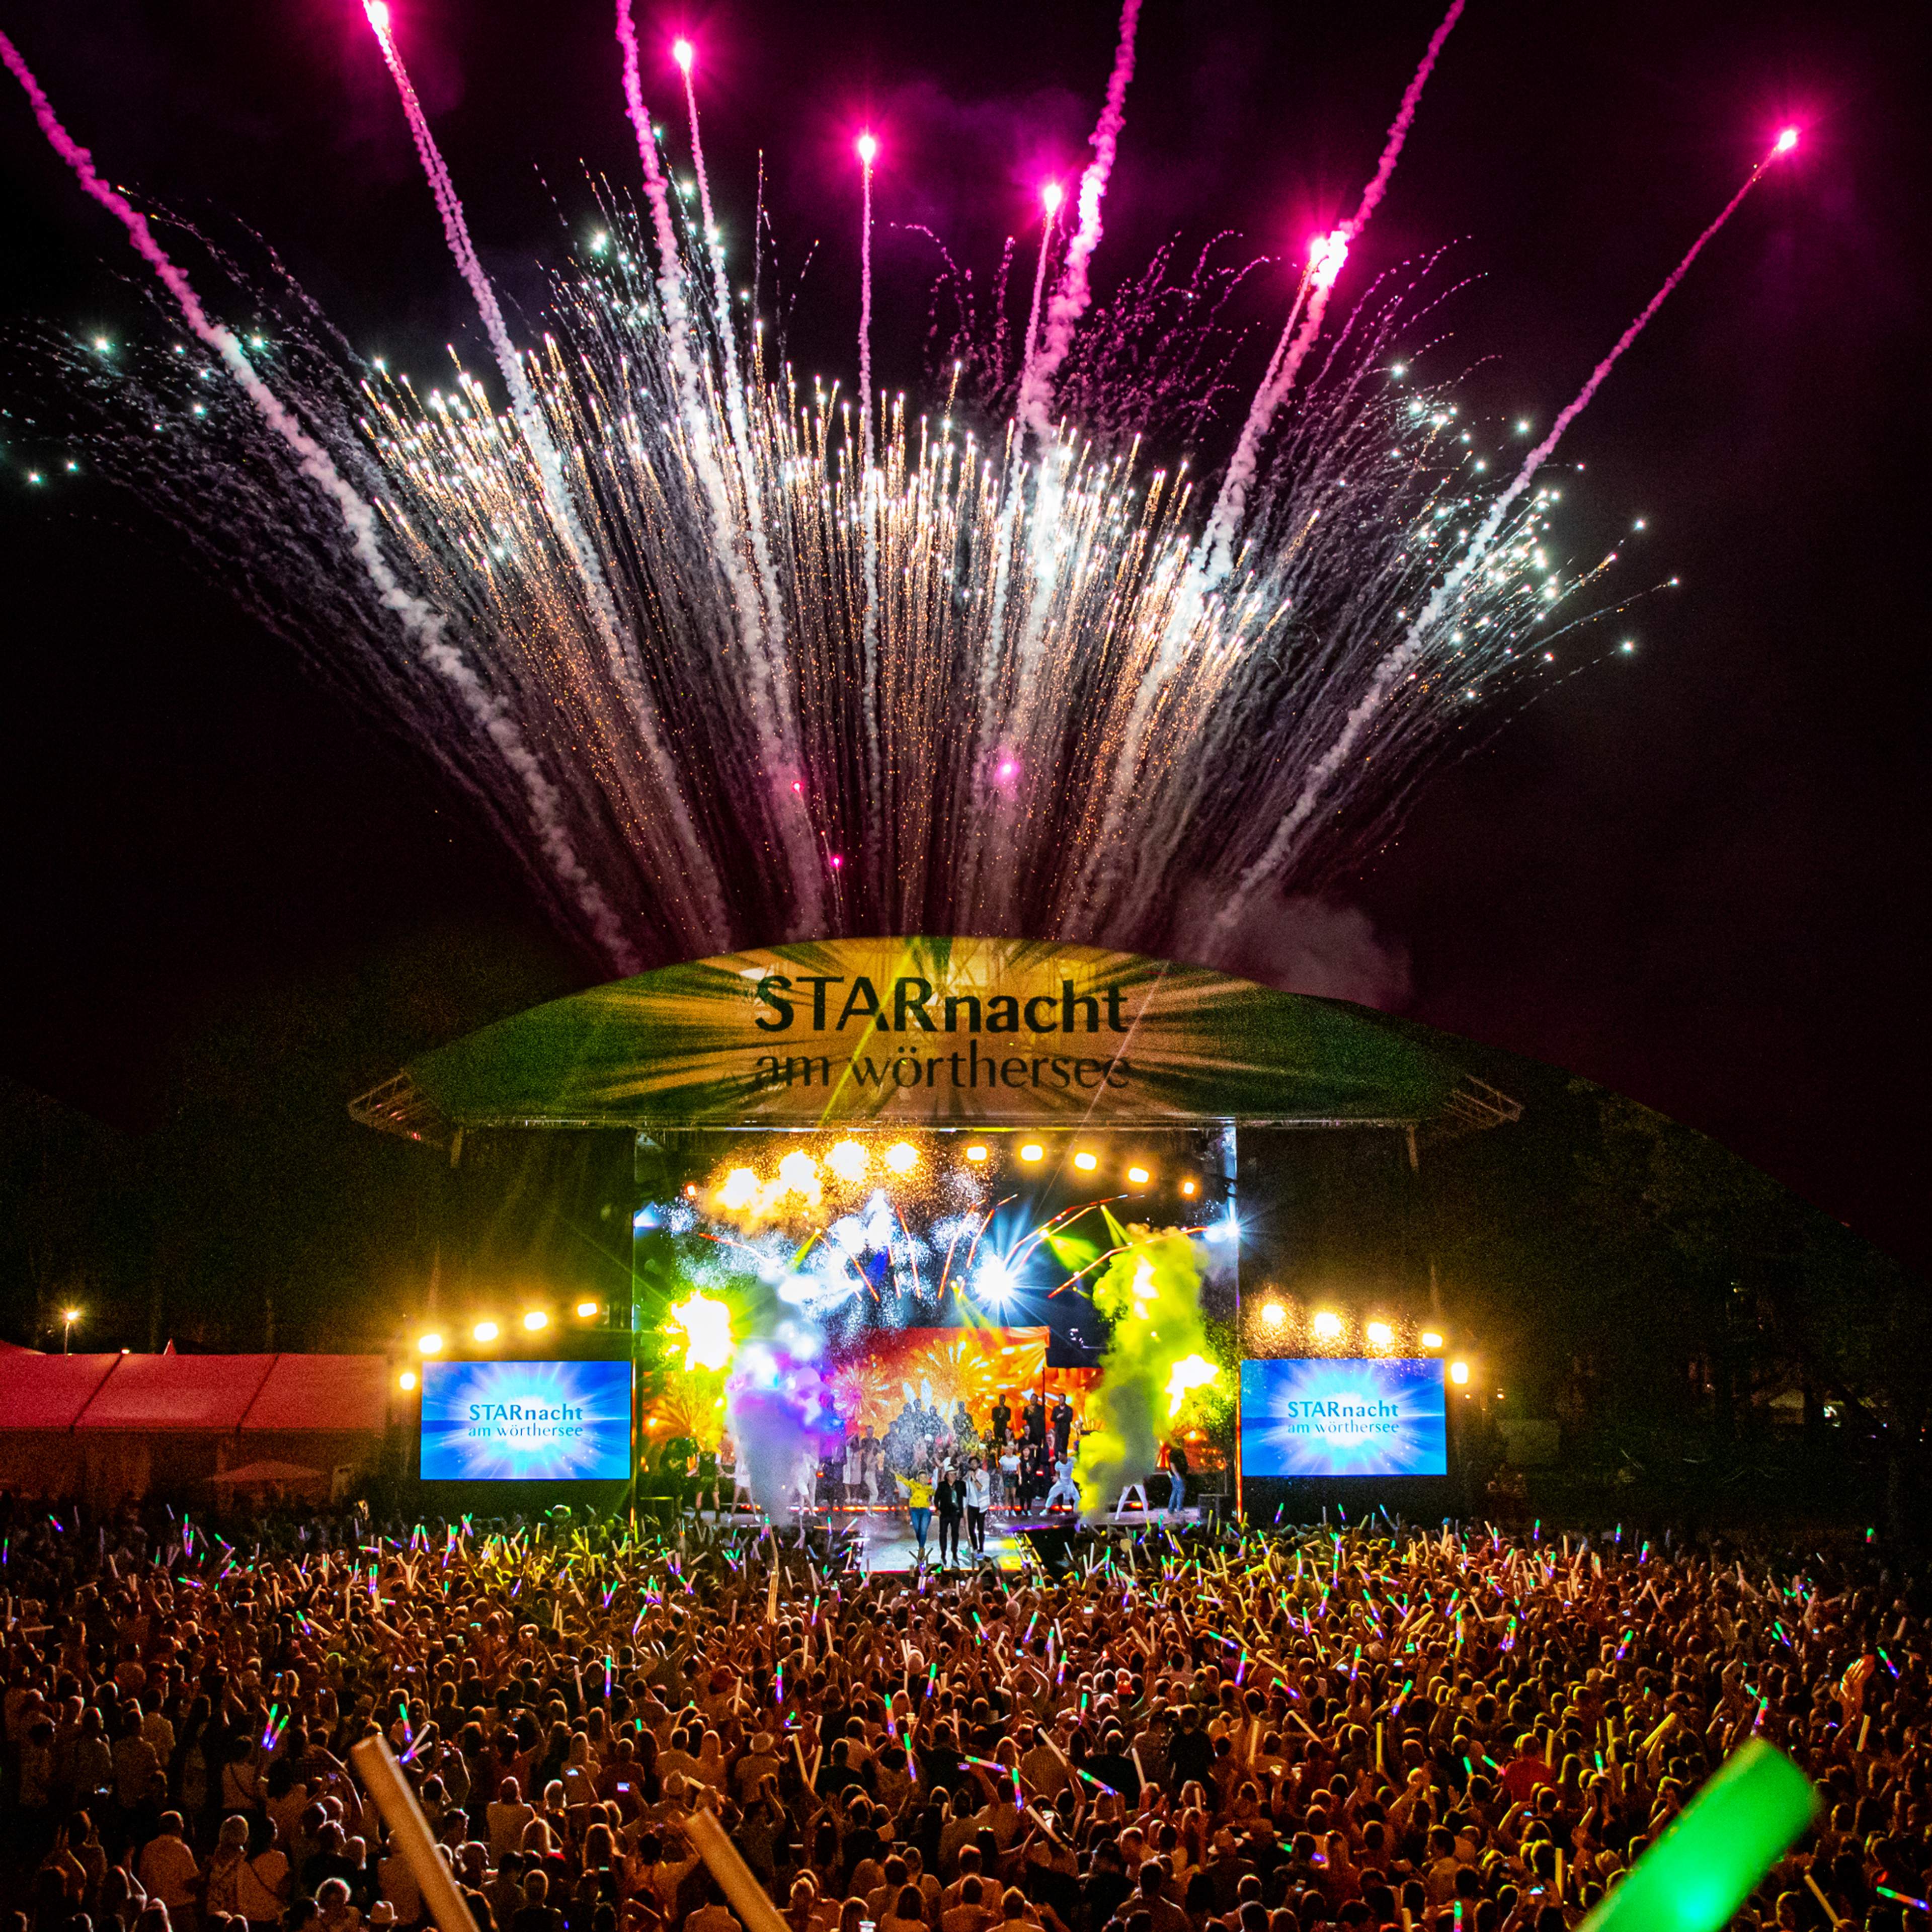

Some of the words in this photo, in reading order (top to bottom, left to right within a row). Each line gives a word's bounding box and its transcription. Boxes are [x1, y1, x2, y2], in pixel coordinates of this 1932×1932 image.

[755, 975, 1129, 1033] STARnacht
[756, 1056, 829, 1087] am
[851, 1039, 1129, 1088] wörthersee
[469, 1403, 584, 1421] STARnacht
[1287, 1400, 1399, 1417] STARnacht
[468, 1427, 491, 1437] am
[497, 1423, 583, 1437] wörthersee
[1287, 1423, 1309, 1433] am
[1315, 1419, 1400, 1433] wörthersee
